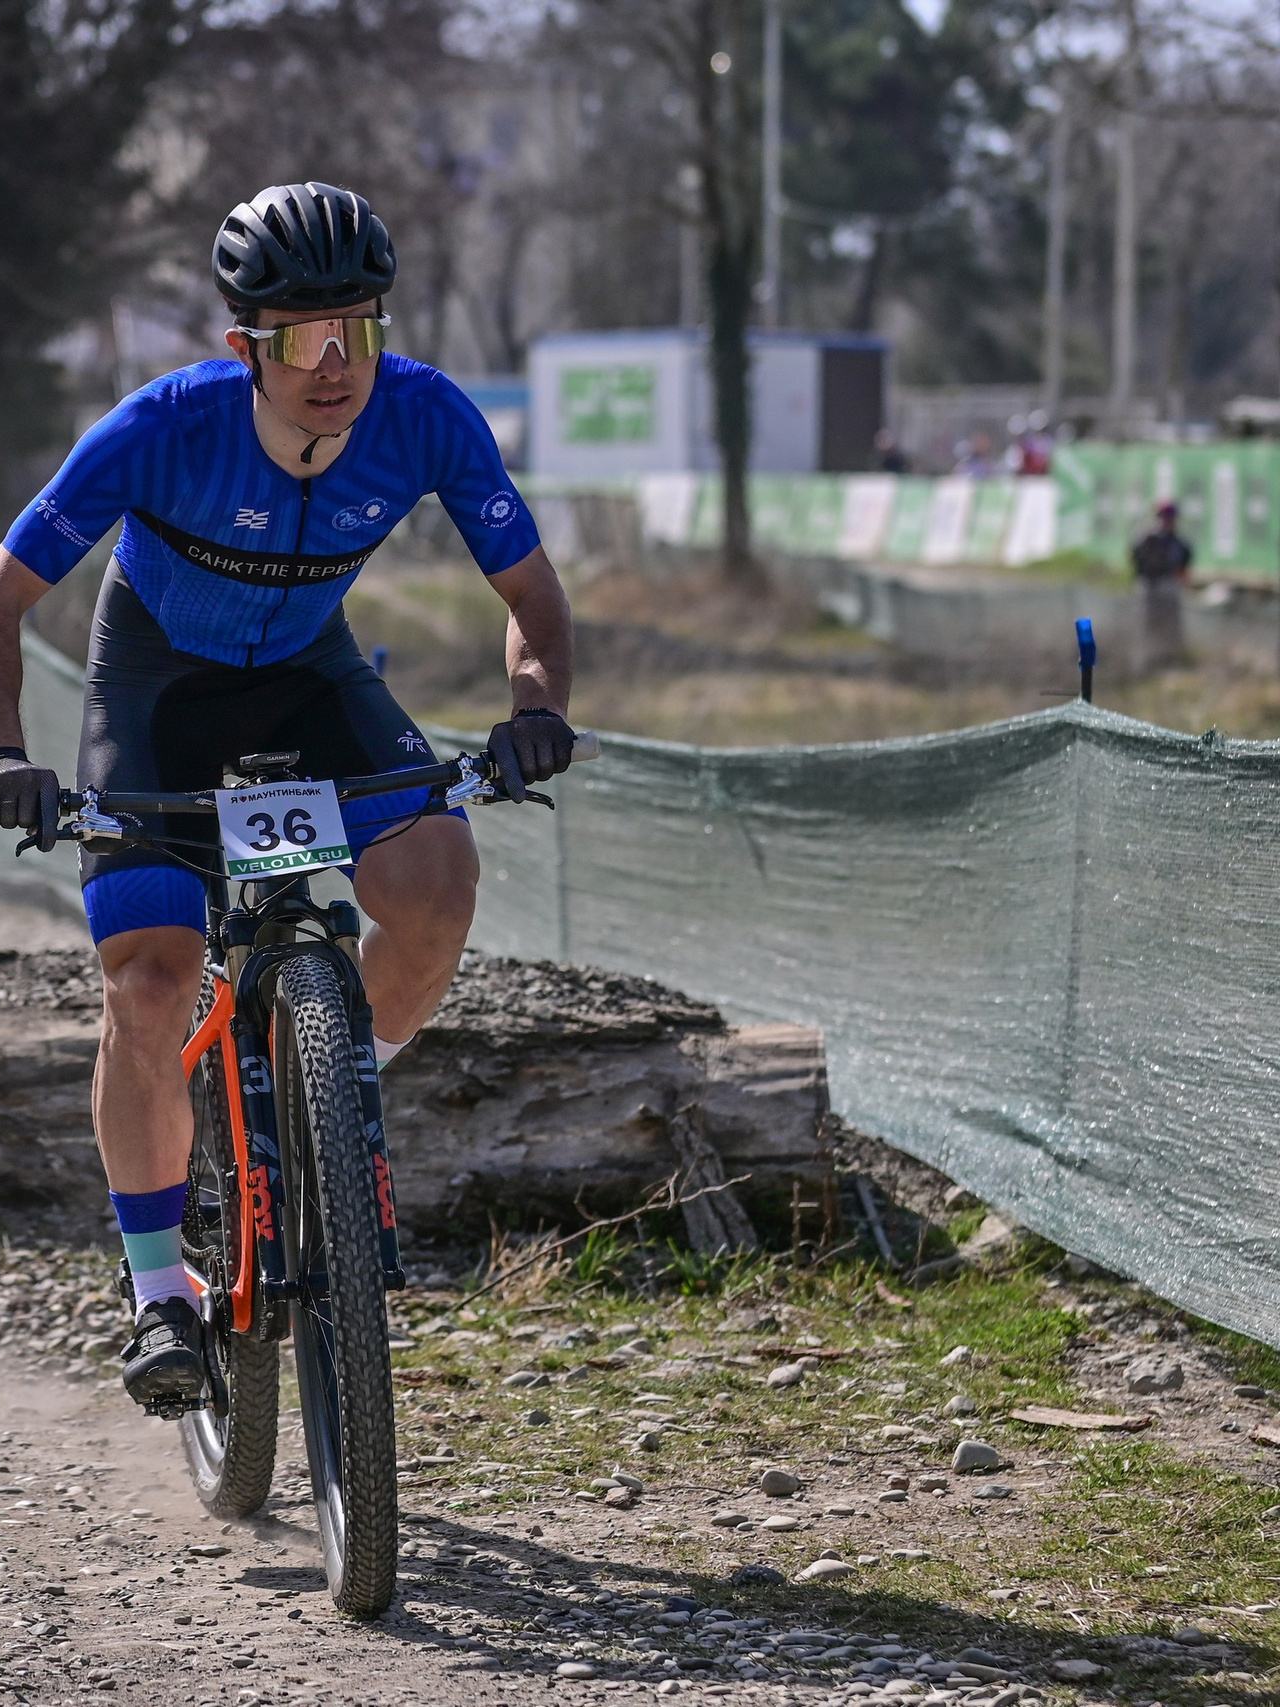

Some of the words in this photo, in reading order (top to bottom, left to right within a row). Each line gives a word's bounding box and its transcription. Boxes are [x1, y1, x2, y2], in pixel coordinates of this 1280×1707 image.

[52, 522, 86, 547] ПЕТЕРБУРГ
[266, 754, 290, 762] GARMIN
[230, 796, 238, 804] Я
[248, 788, 322, 802] МАУНТИНБАЙК
[246, 808, 317, 851] 36
[250, 1164, 275, 1242] FOX
[373, 1153, 397, 1229] FOX
